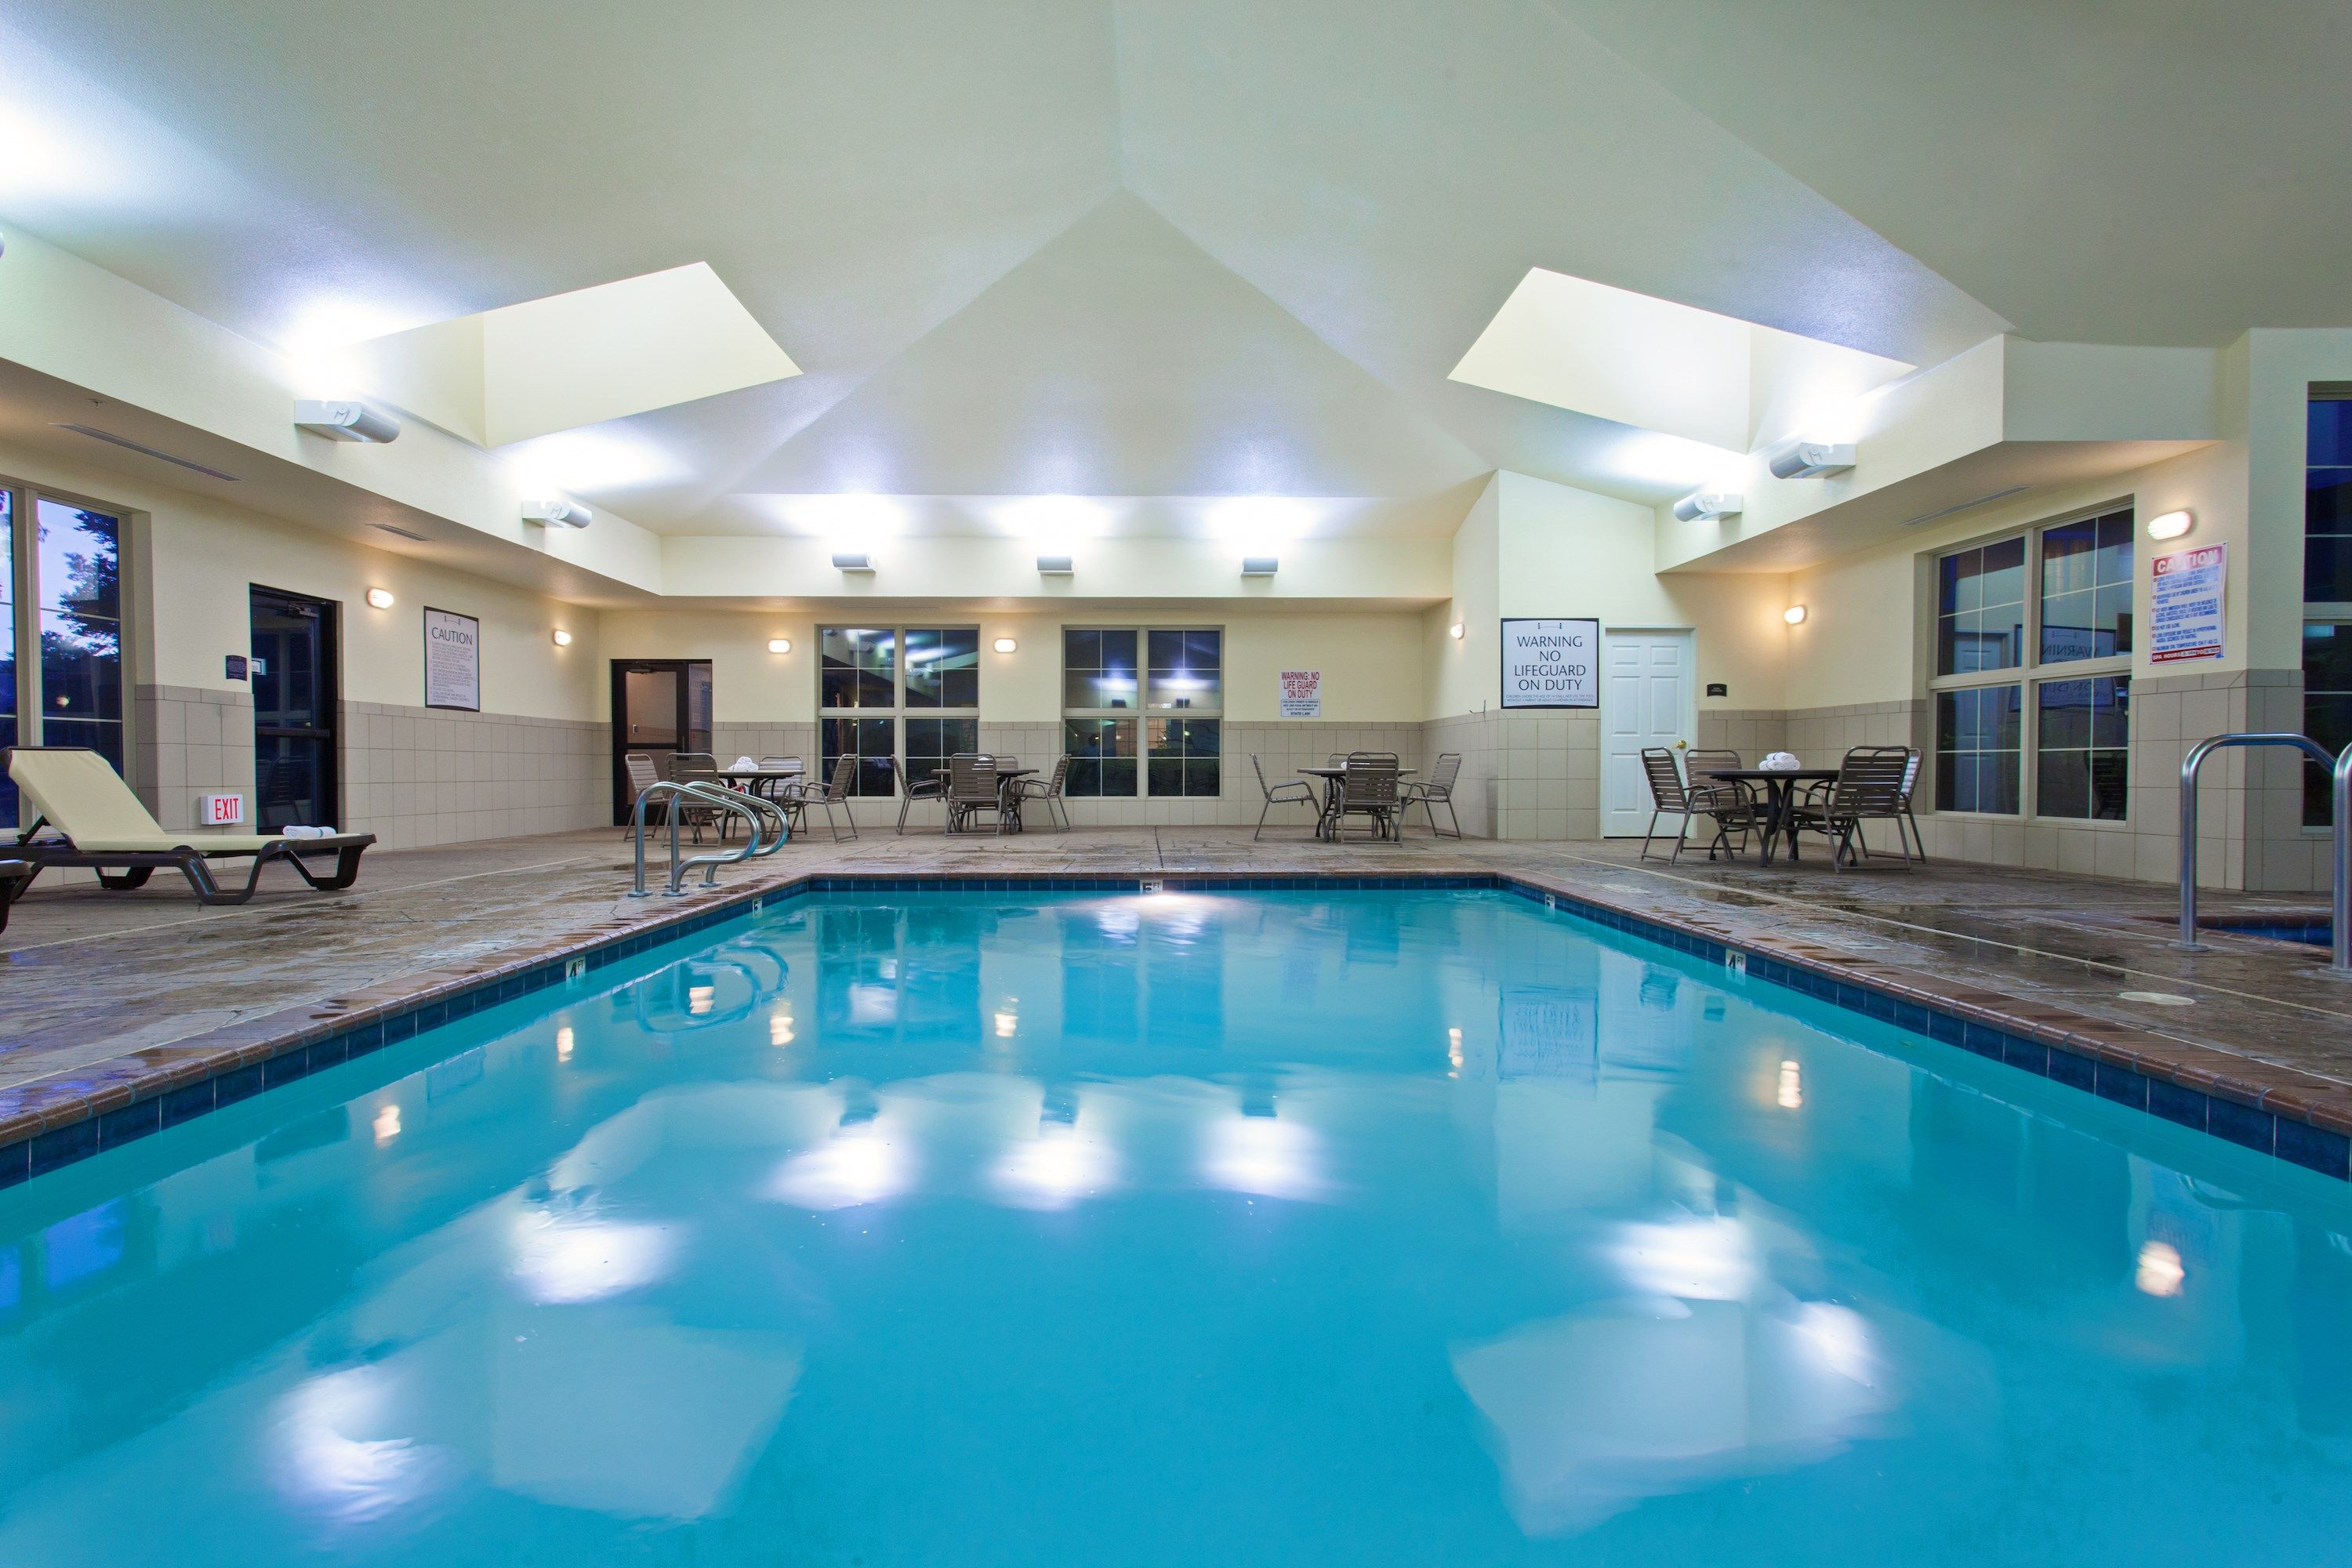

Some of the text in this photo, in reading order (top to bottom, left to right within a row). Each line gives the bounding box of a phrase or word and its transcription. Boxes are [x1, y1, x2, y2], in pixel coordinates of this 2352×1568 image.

[431, 626, 473, 645] CAUTION
[1517, 636, 1583, 648] WARNING
[1539, 650, 1561, 662] NO
[1281, 672, 1319, 681] WARNING: NO
[1514, 665, 1586, 677] LIFEGUARD
[1283, 681, 1317, 689] LIFE GUARD
[1519, 679, 1582, 691] ON DUTY
[1288, 690, 1313, 698] ON DUTY
[214, 798, 239, 820] EXIT
[578, 959, 584, 970] FT
[1737, 956, 1744, 966] FT
